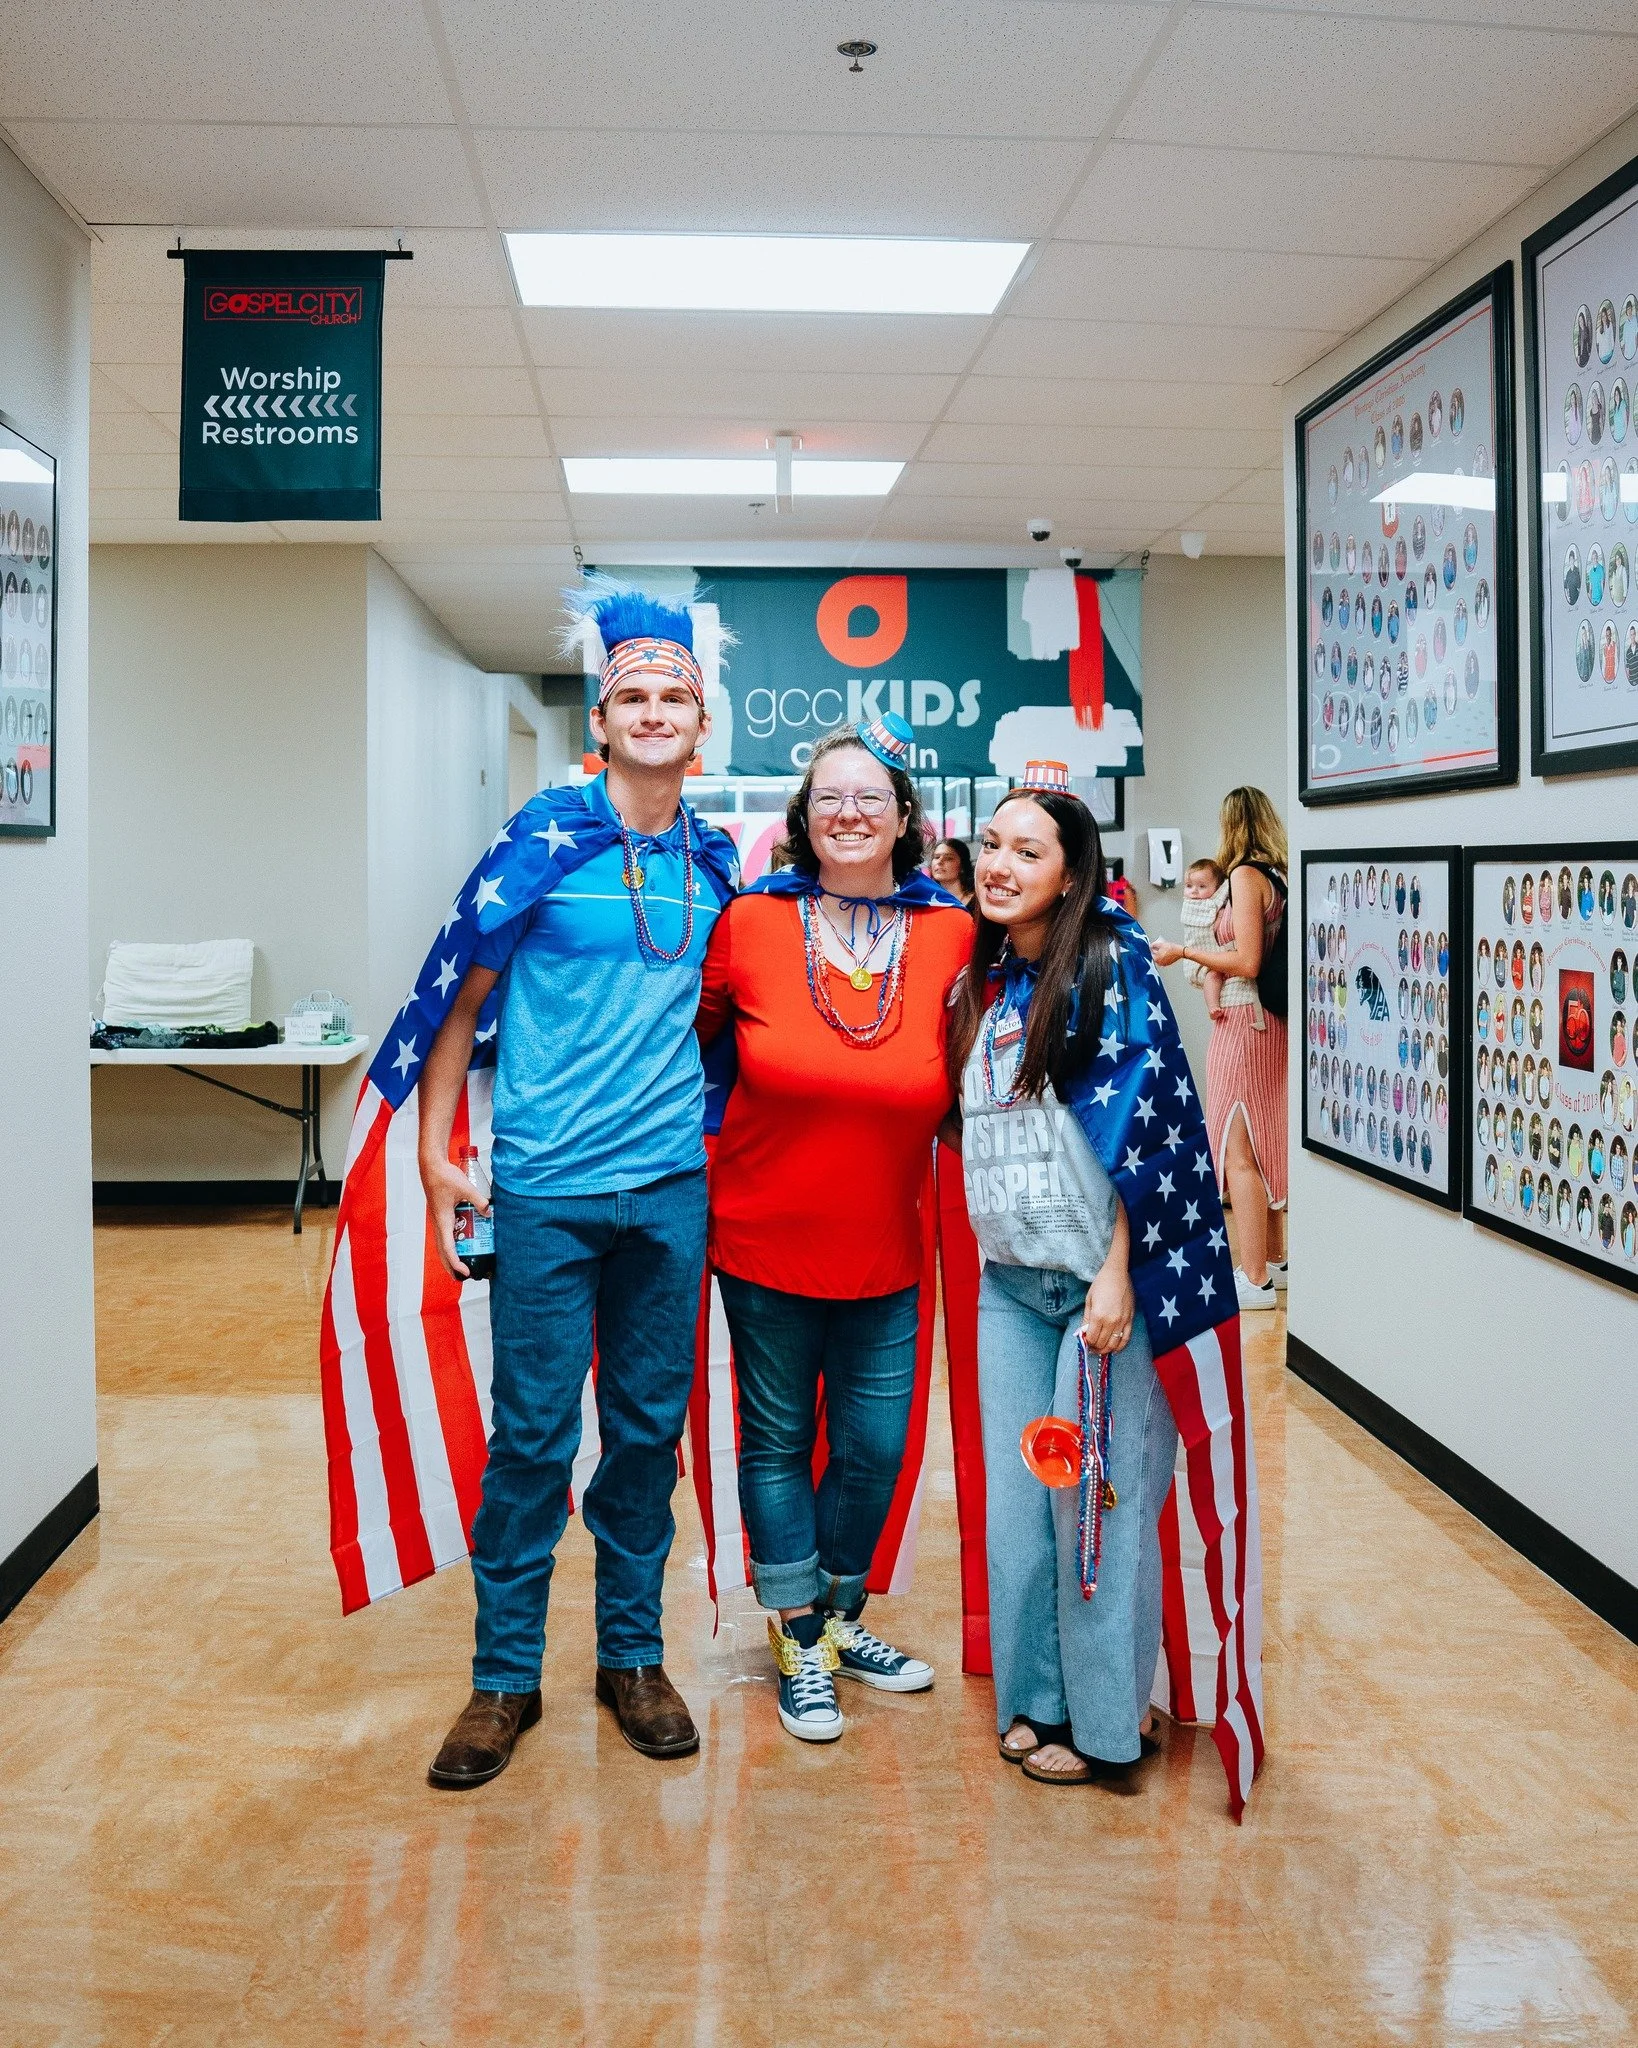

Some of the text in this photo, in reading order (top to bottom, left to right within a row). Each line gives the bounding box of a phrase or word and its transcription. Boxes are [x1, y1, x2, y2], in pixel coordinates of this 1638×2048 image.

[209, 292, 357, 314] GOSPELCITY
[310, 313, 357, 325] CHURCH
[220, 366, 341, 393] Worship
[202, 422, 359, 445] Restrooms
[1555, 1082, 1572, 1110] Class
[1573, 1091, 1581, 1113] of
